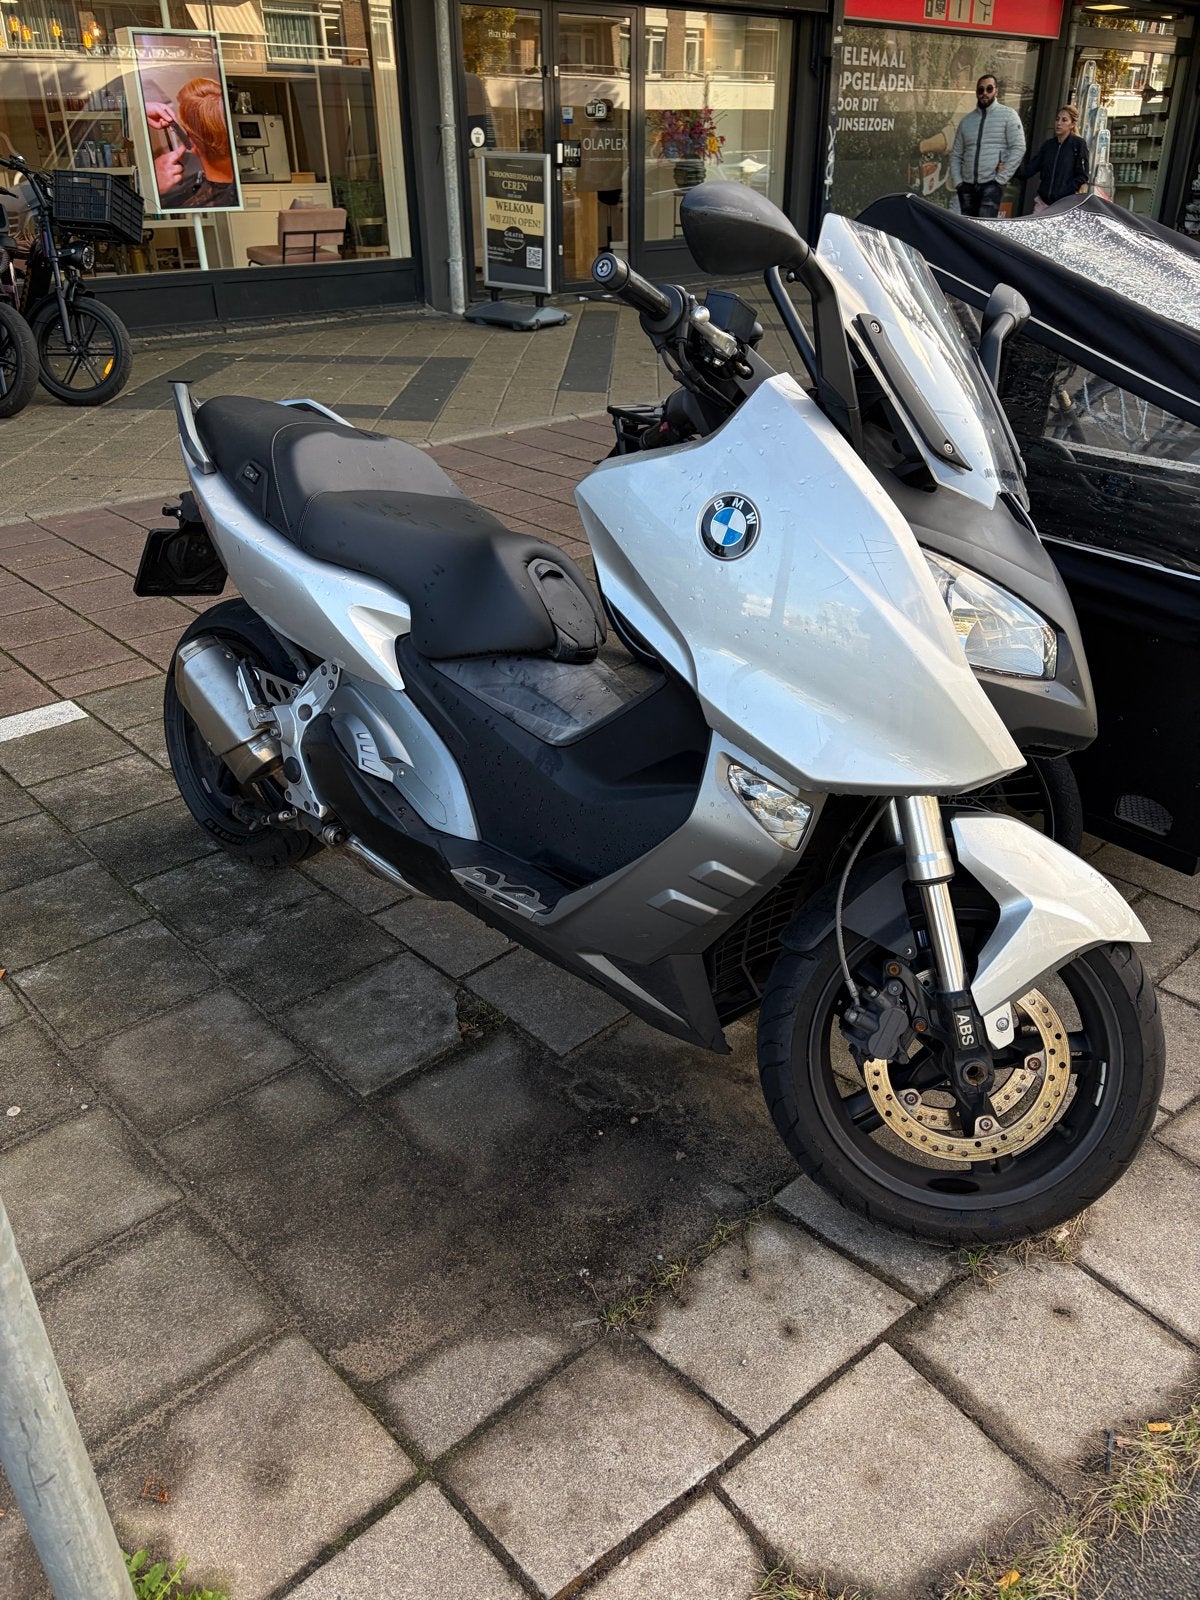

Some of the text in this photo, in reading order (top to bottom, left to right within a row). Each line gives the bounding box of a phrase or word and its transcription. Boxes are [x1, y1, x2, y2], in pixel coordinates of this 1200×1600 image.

[841, 46, 906, 68] ELEMAAL
[840, 71, 915, 92] PGELADEN
[837, 97, 880, 112] OOR DIT
[582, 137, 628, 151] OLAPLEX
[501, 180, 528, 191] CEREN
[495, 200, 534, 215] WELKOM
[518, 217, 541, 229] OPEN!
[713, 497, 757, 525] BMW
[957, 1014, 975, 1046] ABS
